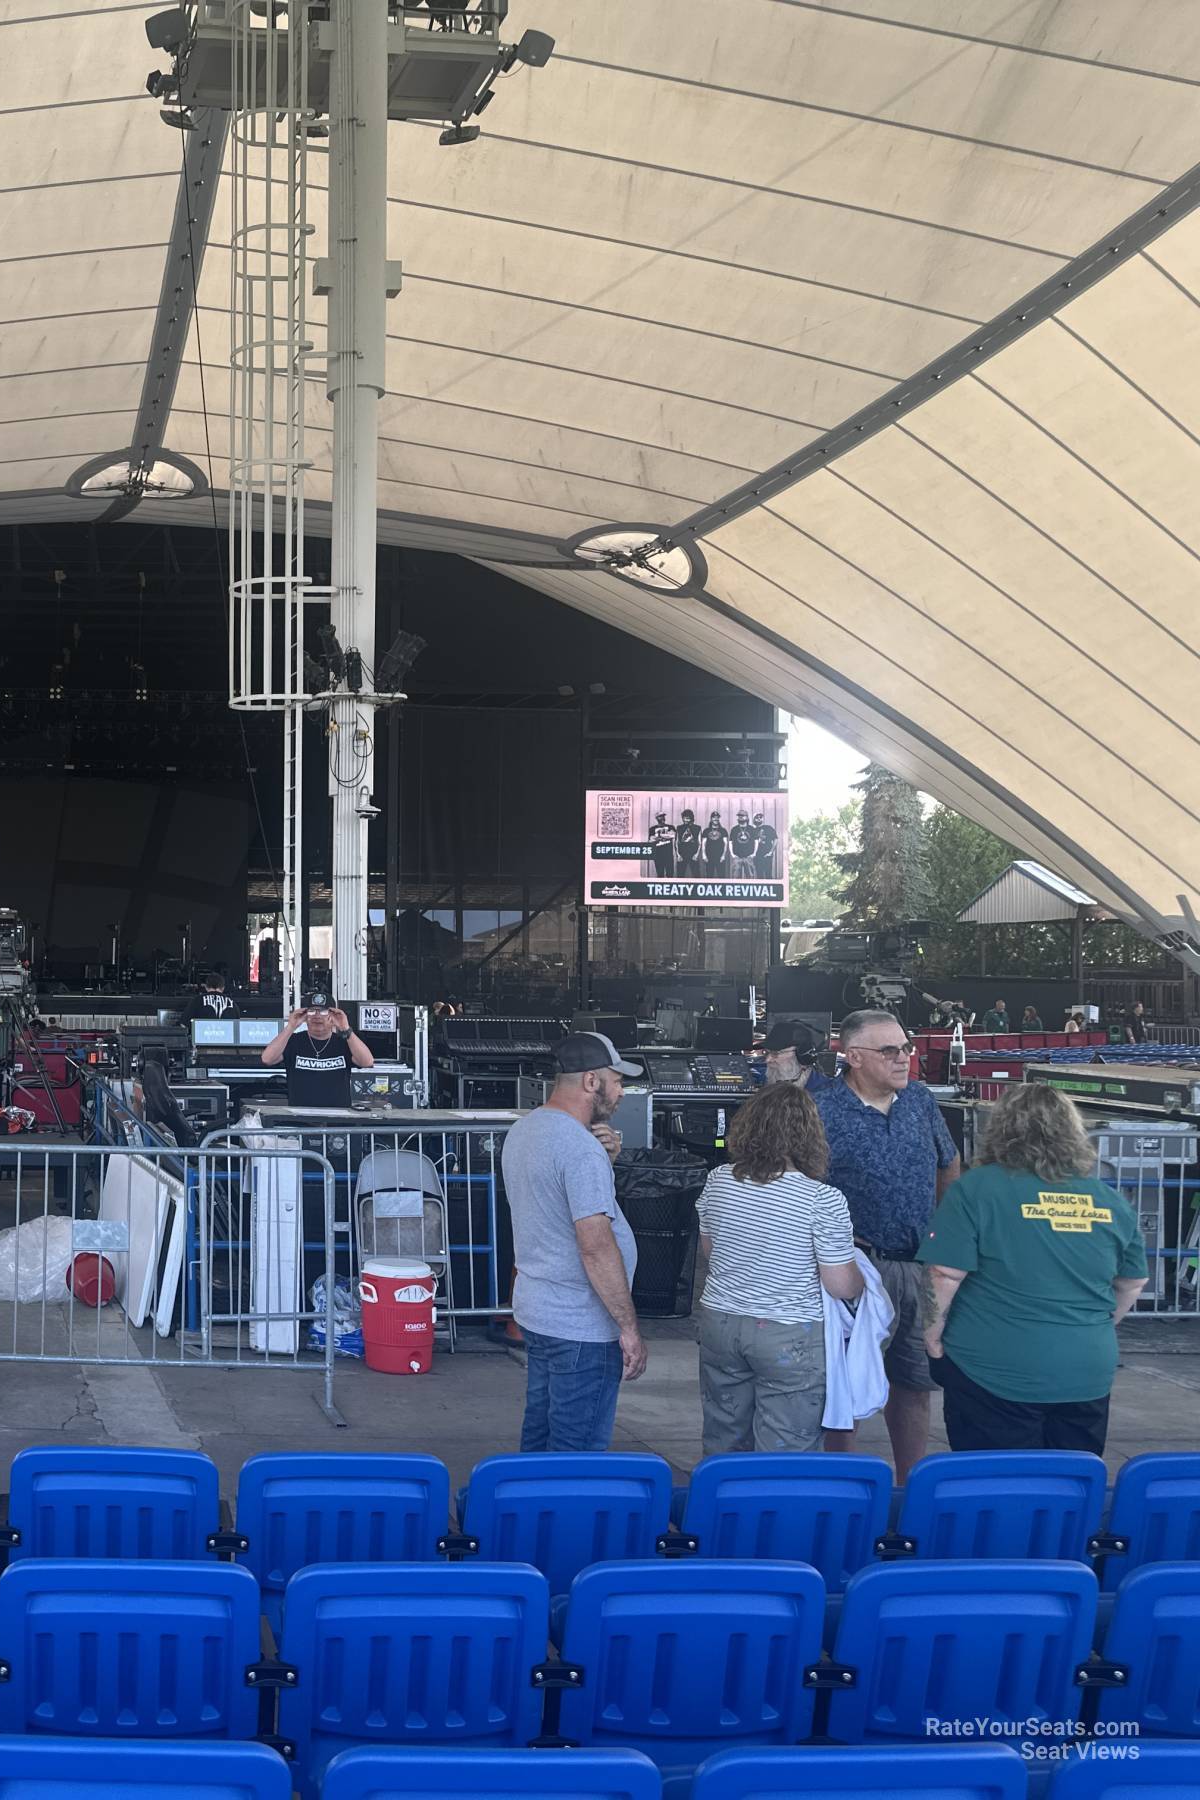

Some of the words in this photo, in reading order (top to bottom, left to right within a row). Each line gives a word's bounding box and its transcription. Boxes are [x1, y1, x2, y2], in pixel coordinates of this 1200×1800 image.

[596, 846, 640, 854] SEPTEMBER
[647, 884, 694, 896] TREATY
[696, 884, 722, 896] OAK
[725, 885, 777, 897] REVIVAL
[203, 994, 234, 1019] HEAVY
[364, 1009, 380, 1018] NO
[297, 1058, 344, 1068] MAVRICKS
[1042, 1194, 1077, 1205] MUSIC
[1078, 1197, 1089, 1205] IN
[1025, 1206, 1046, 1216] The
[1047, 1208, 1079, 1217] Great
[1080, 1209, 1109, 1220] Lakes
